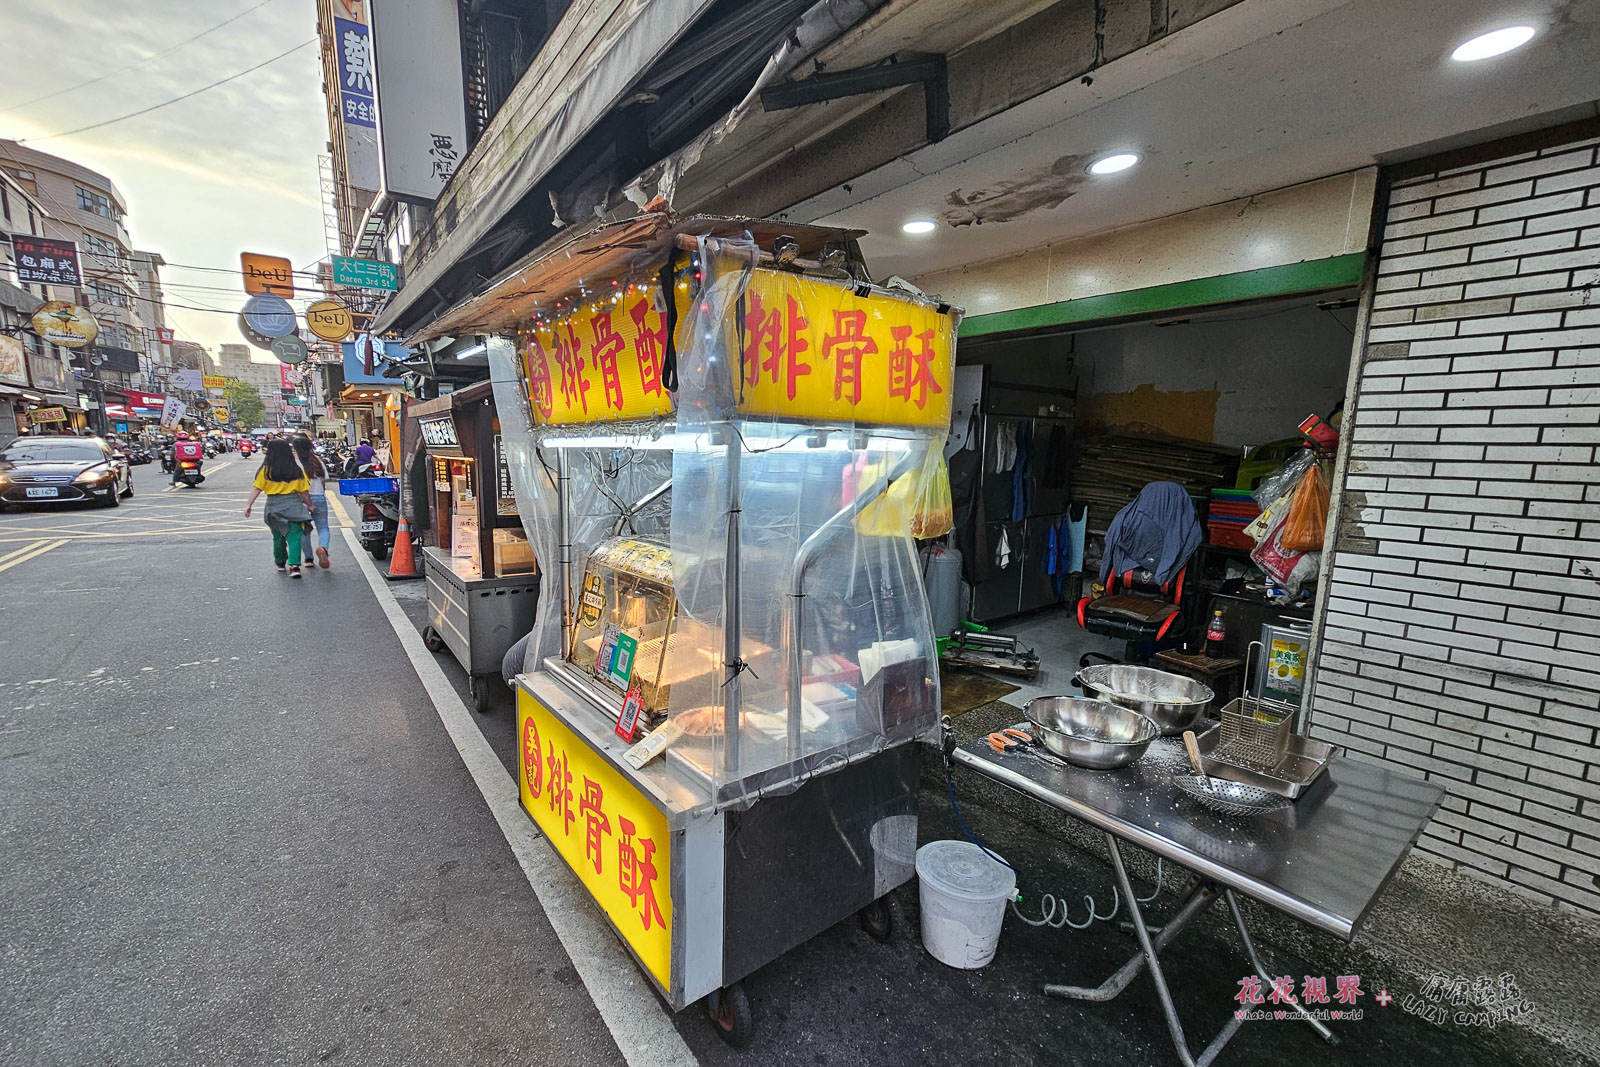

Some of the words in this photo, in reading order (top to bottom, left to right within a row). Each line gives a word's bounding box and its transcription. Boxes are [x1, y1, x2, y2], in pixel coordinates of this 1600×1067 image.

[20, 254, 75, 272] 包廂式
[340, 259, 391, 278] 大仁三街
[248, 264, 288, 282] beU
[340, 273, 363, 284] Daren
[365, 277, 379, 286] 3rd
[313, 310, 345, 326] beU
[554, 296, 676, 415] 排骨酥
[743, 290, 944, 411] 排骨酥
[546, 738, 667, 931] 排骨酥
